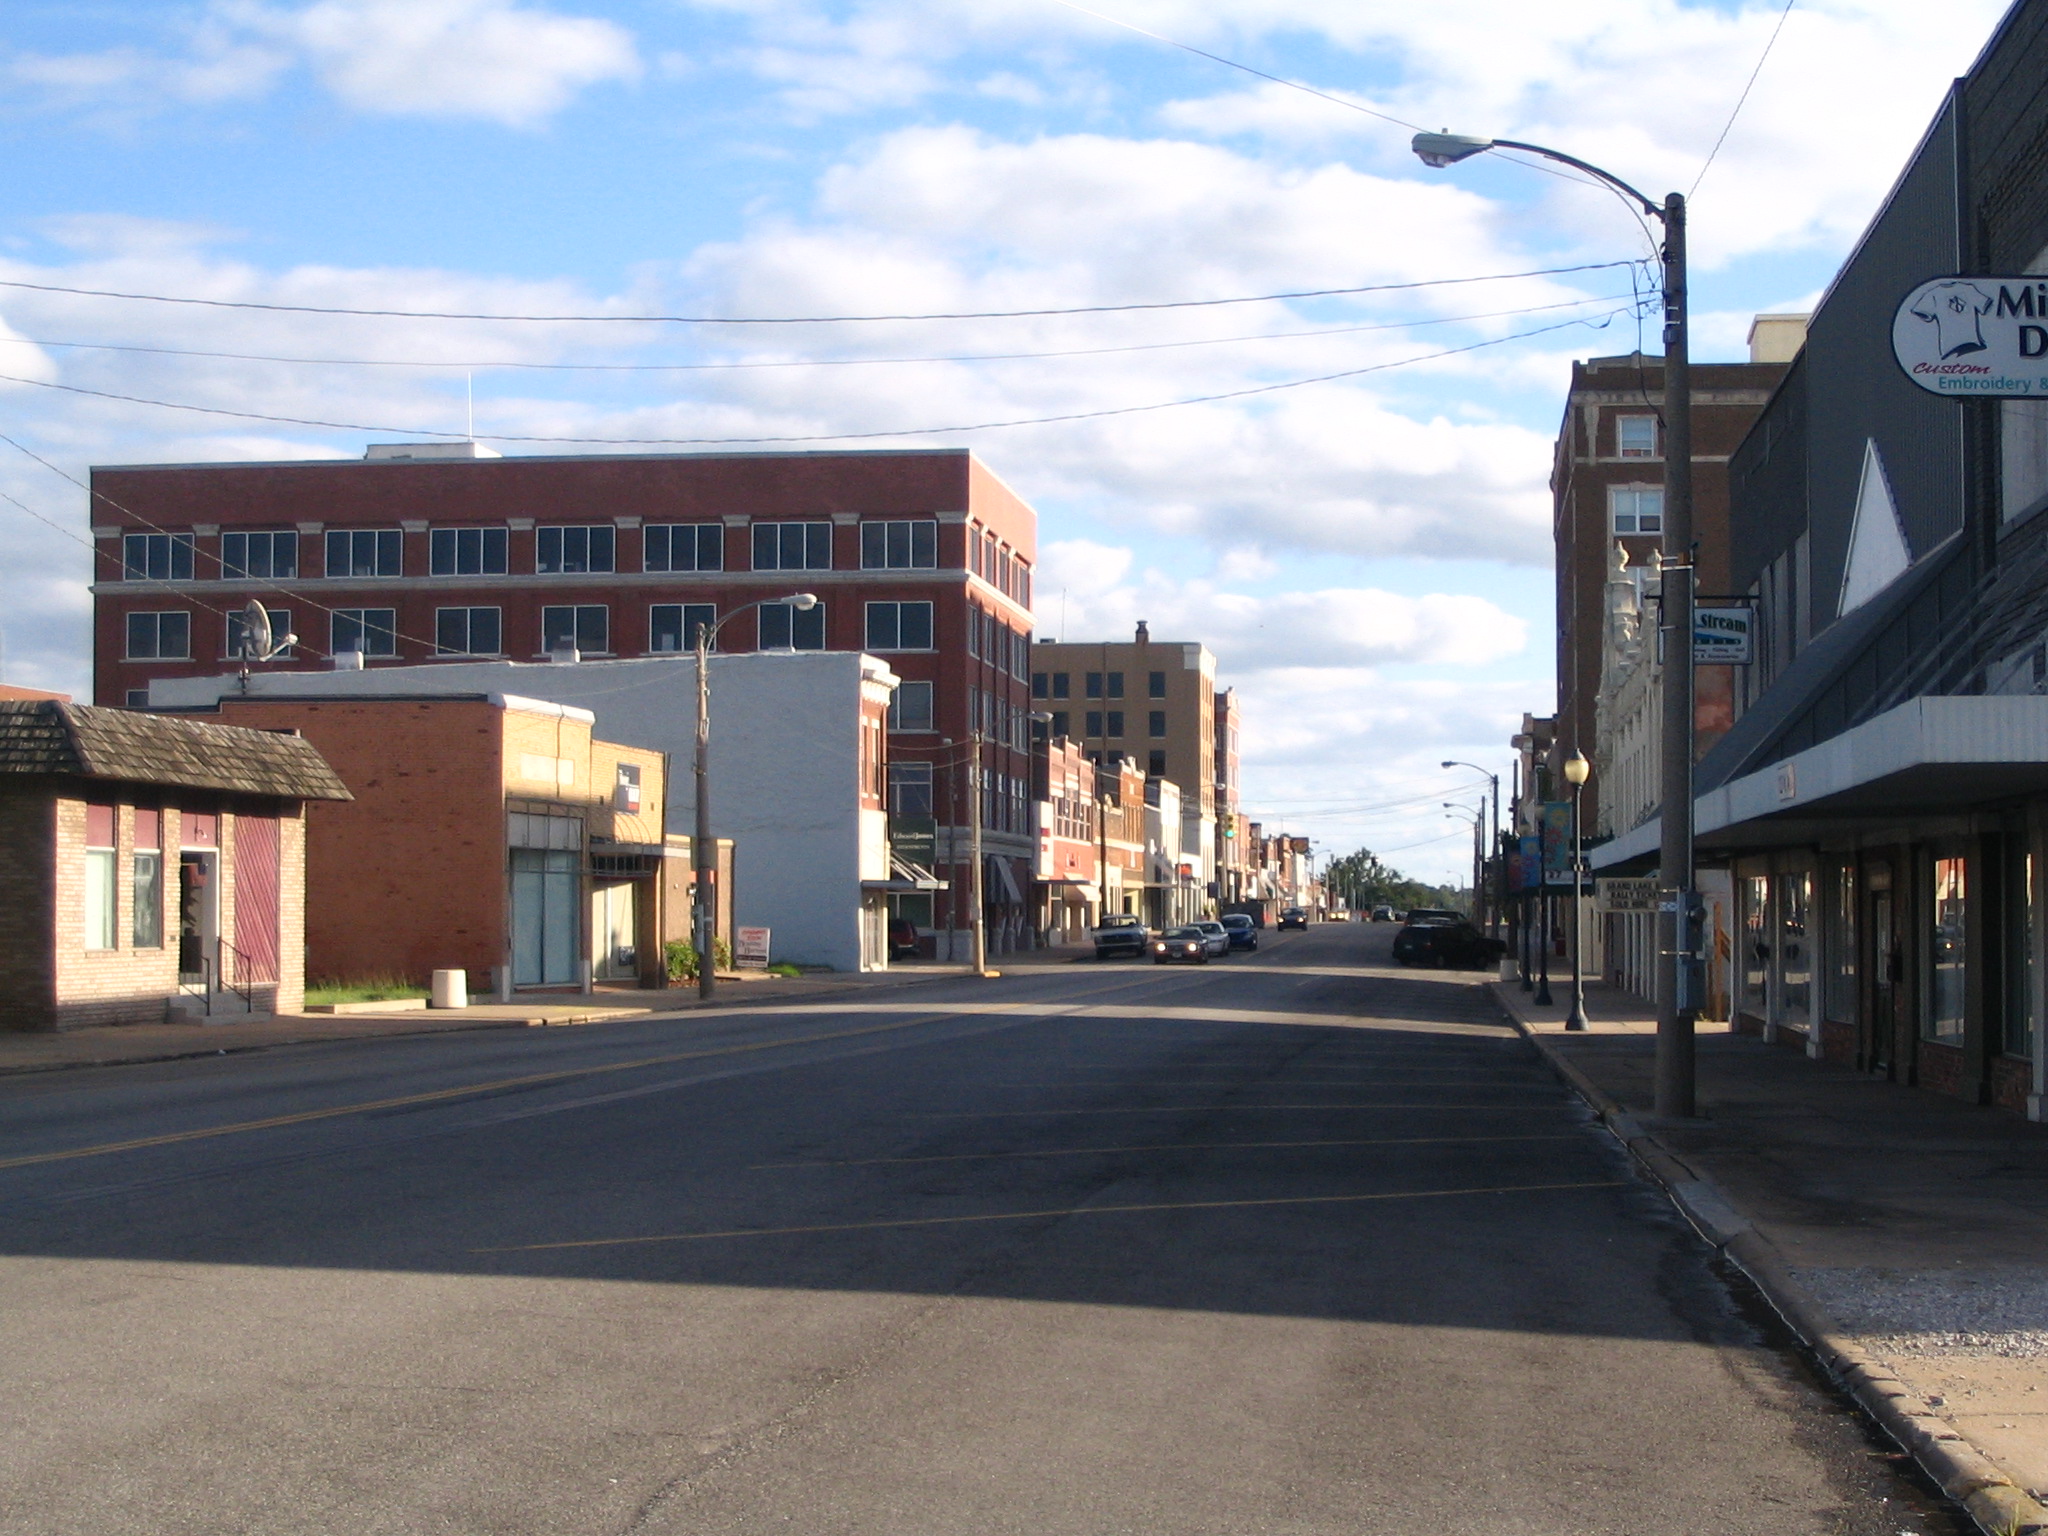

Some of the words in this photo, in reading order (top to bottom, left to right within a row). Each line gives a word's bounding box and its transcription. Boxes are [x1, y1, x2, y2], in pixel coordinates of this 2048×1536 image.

[1913, 362, 1991, 375] Custom
[1938, 376, 2032, 394] Embroidery
[1701, 613, 1747, 634] Stream
